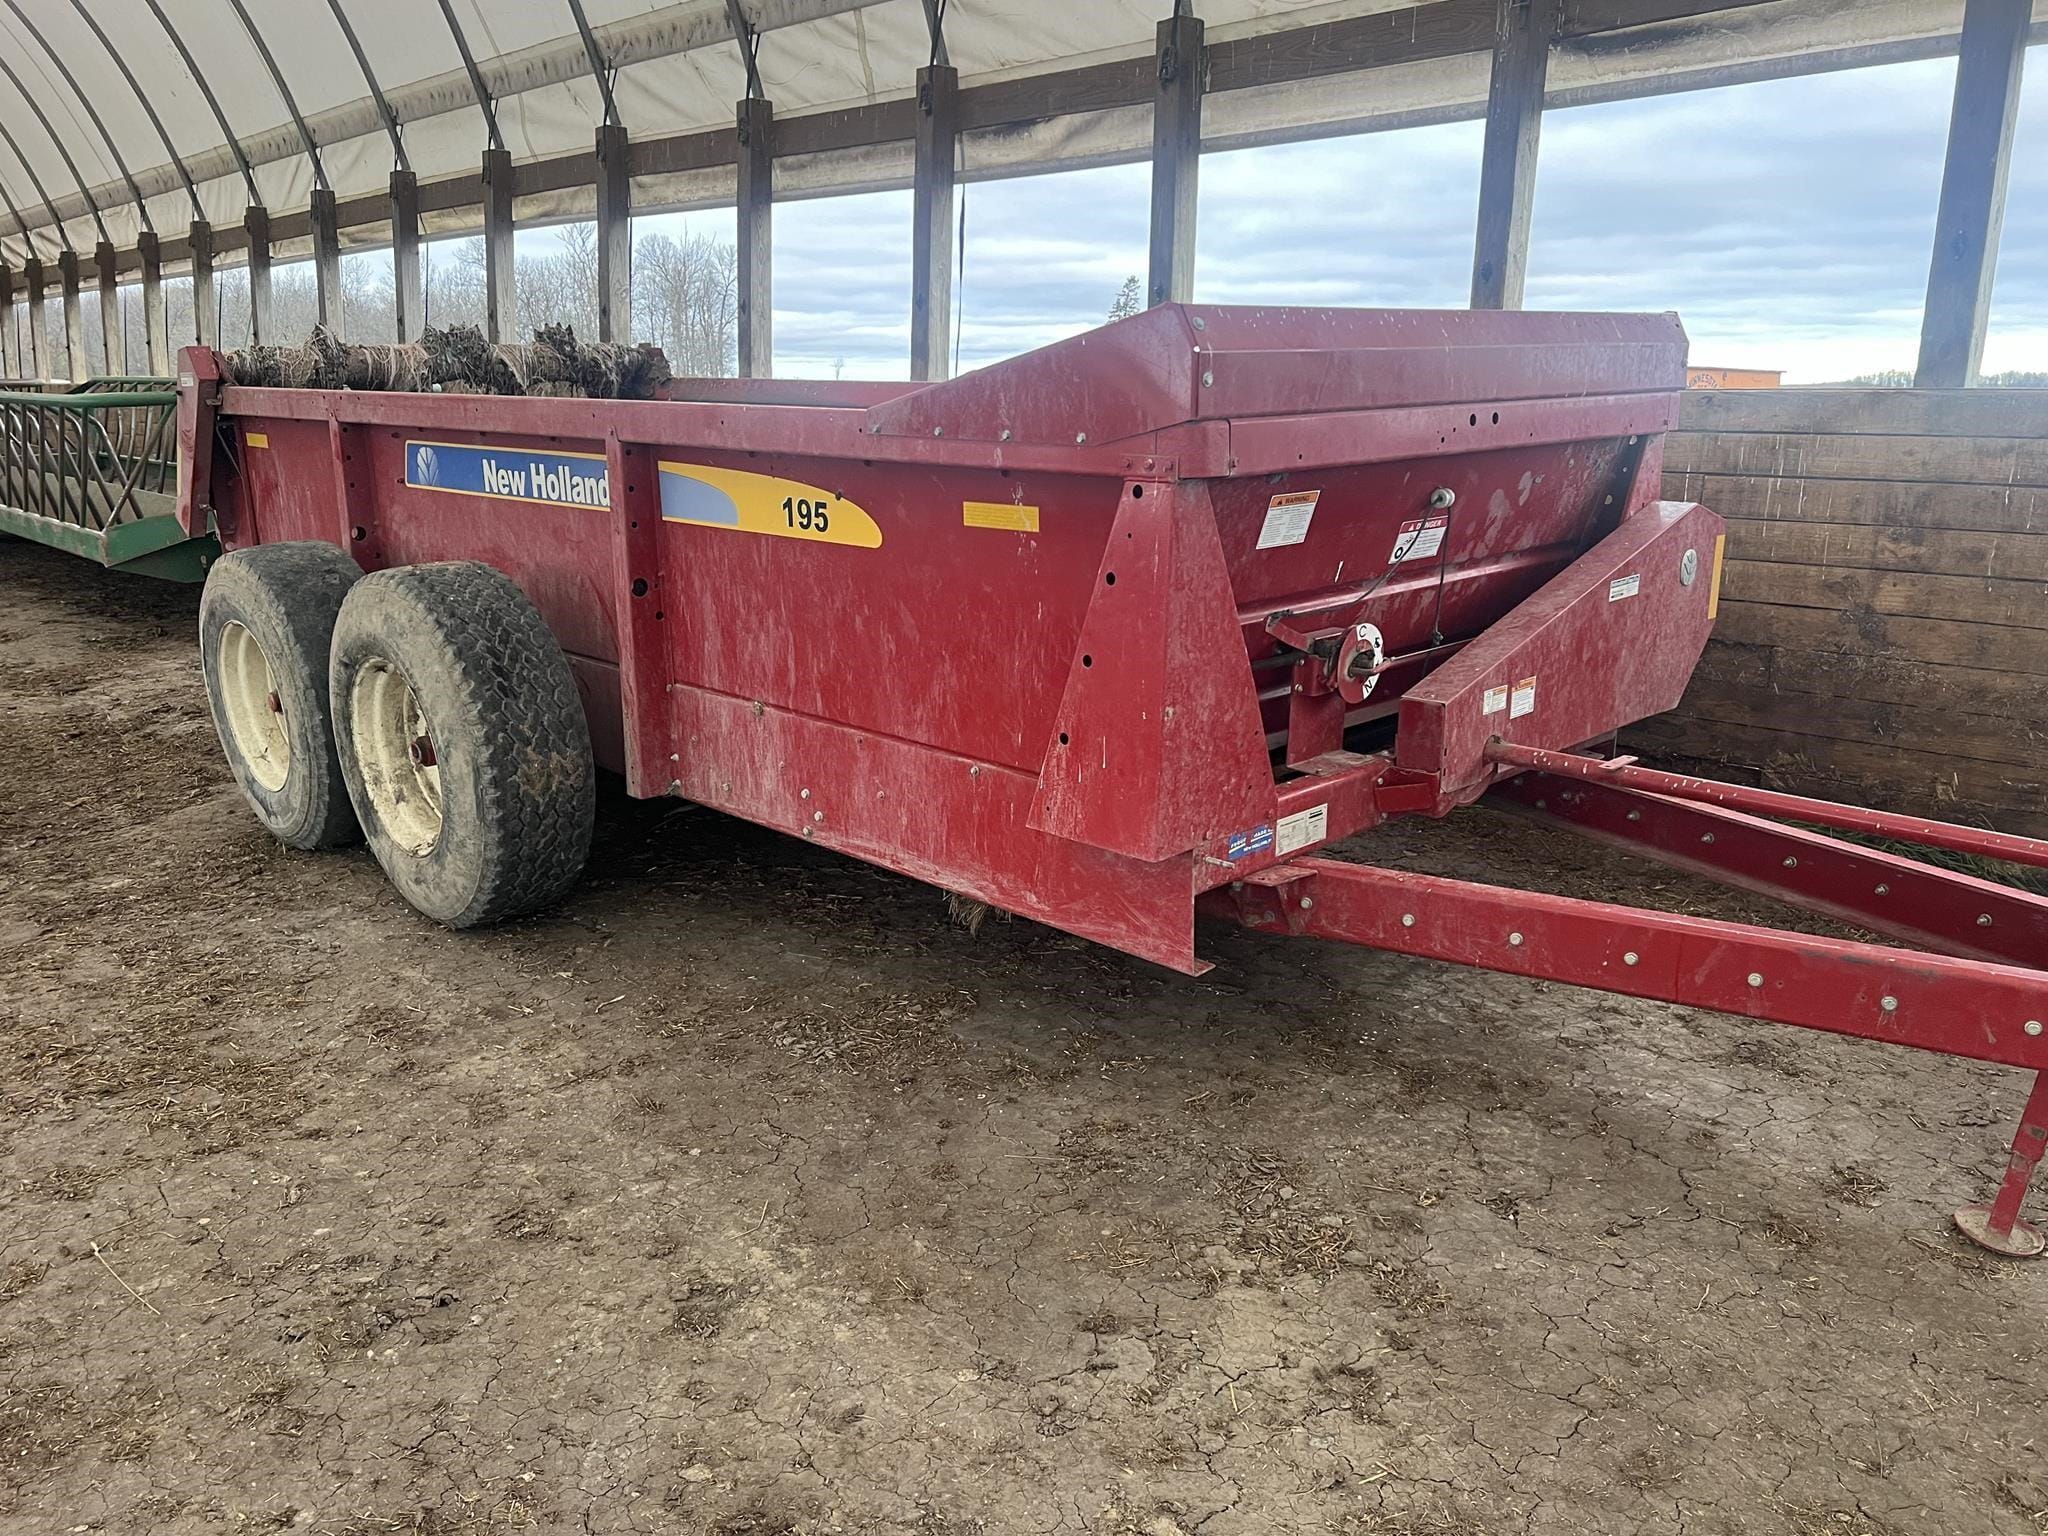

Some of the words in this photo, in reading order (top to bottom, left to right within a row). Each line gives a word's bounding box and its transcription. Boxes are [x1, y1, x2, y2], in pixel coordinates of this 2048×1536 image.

[482, 459, 525, 496] New
[530, 463, 610, 506] Holland
[1285, 495, 1310, 504] WARNING
[782, 496, 829, 533] 195
[1415, 520, 1442, 530] DNGER
[1359, 625, 1367, 638] C
[1364, 680, 1373, 692] N
